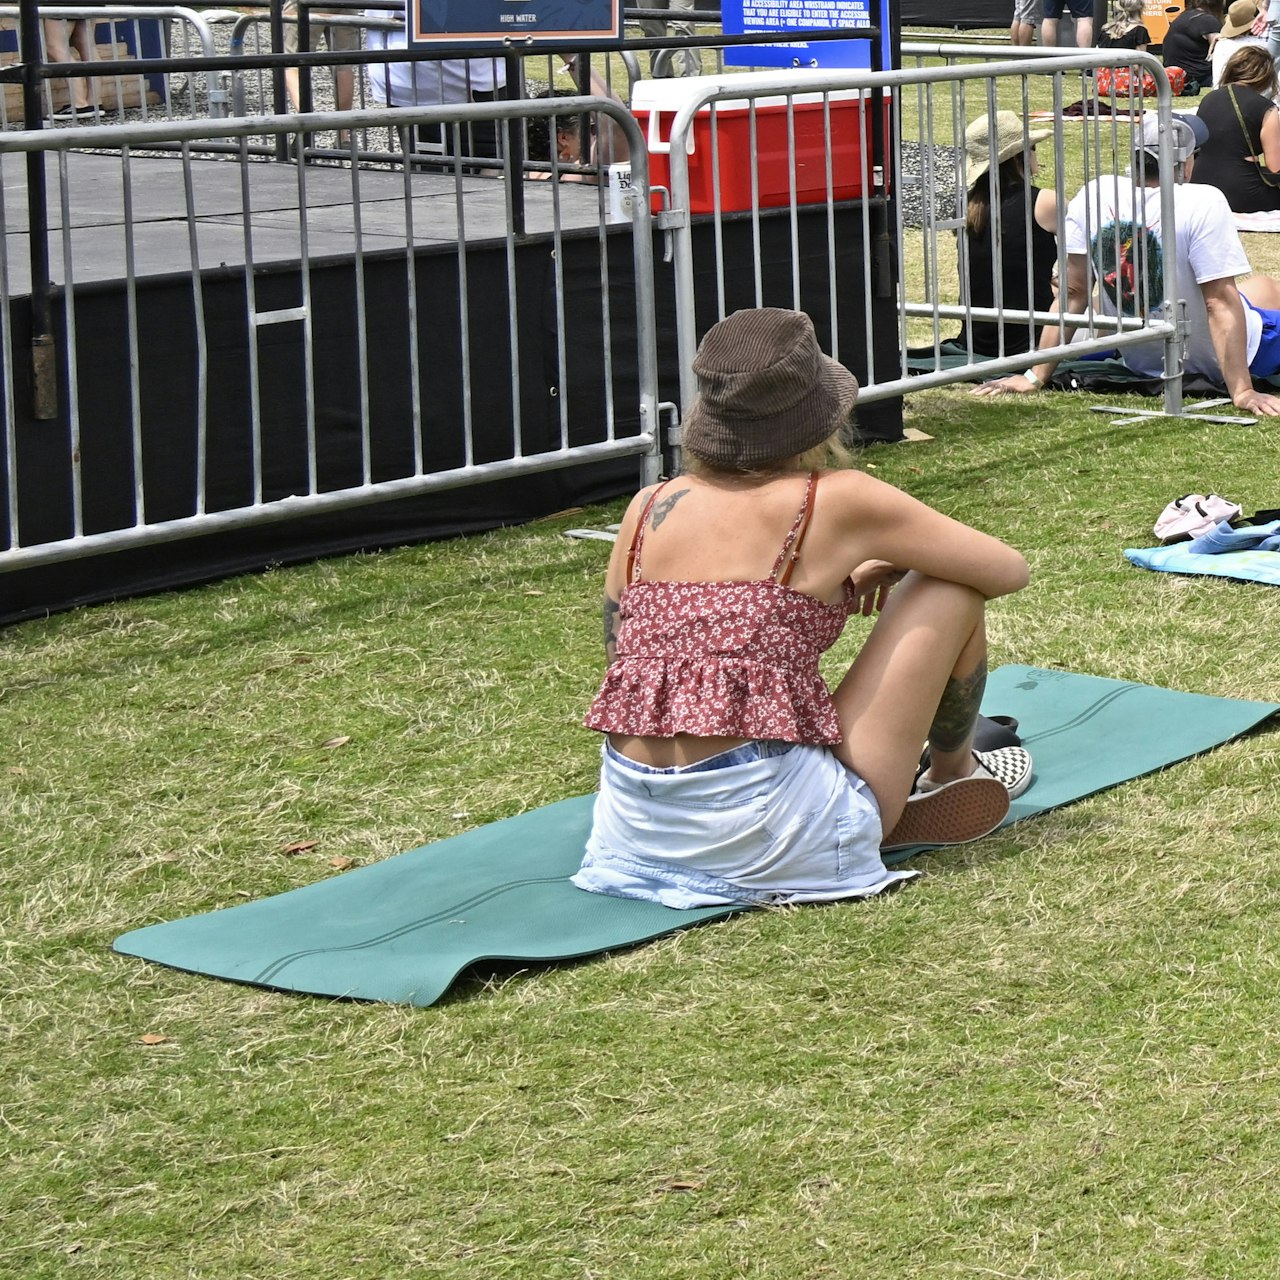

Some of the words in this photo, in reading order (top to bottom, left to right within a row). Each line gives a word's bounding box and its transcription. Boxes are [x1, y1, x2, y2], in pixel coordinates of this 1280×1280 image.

[743, 0, 751, 7] AN
[751, 0, 788, 8] ACCESSIBILITY
[789, 0, 803, 8] AREA
[803, 1, 836, 9] WRISTBAND
[836, 1, 865, 10] INDICATES
[500, 14, 514, 23] HIGH
[516, 13, 537, 23] WATER
[743, 8, 756, 16] THAT
[756, 8, 768, 17] YOU
[768, 9, 779, 17] ARE
[779, 9, 802, 18] ELIGIBLE
[802, 9, 811, 18] TO
[811, 10, 828, 18] ENTER
[828, 10, 840, 18] THE
[840, 10, 870, 19] ACCESSIBL
[743, 17, 765, 26] VIEWING
[765, 18, 779, 26] AREA
[786, 18, 797, 26] ONE
[831, 19, 837, 27] IF
[838, 19, 856, 28] SPACE
[856, 20, 870, 28] ALLO
